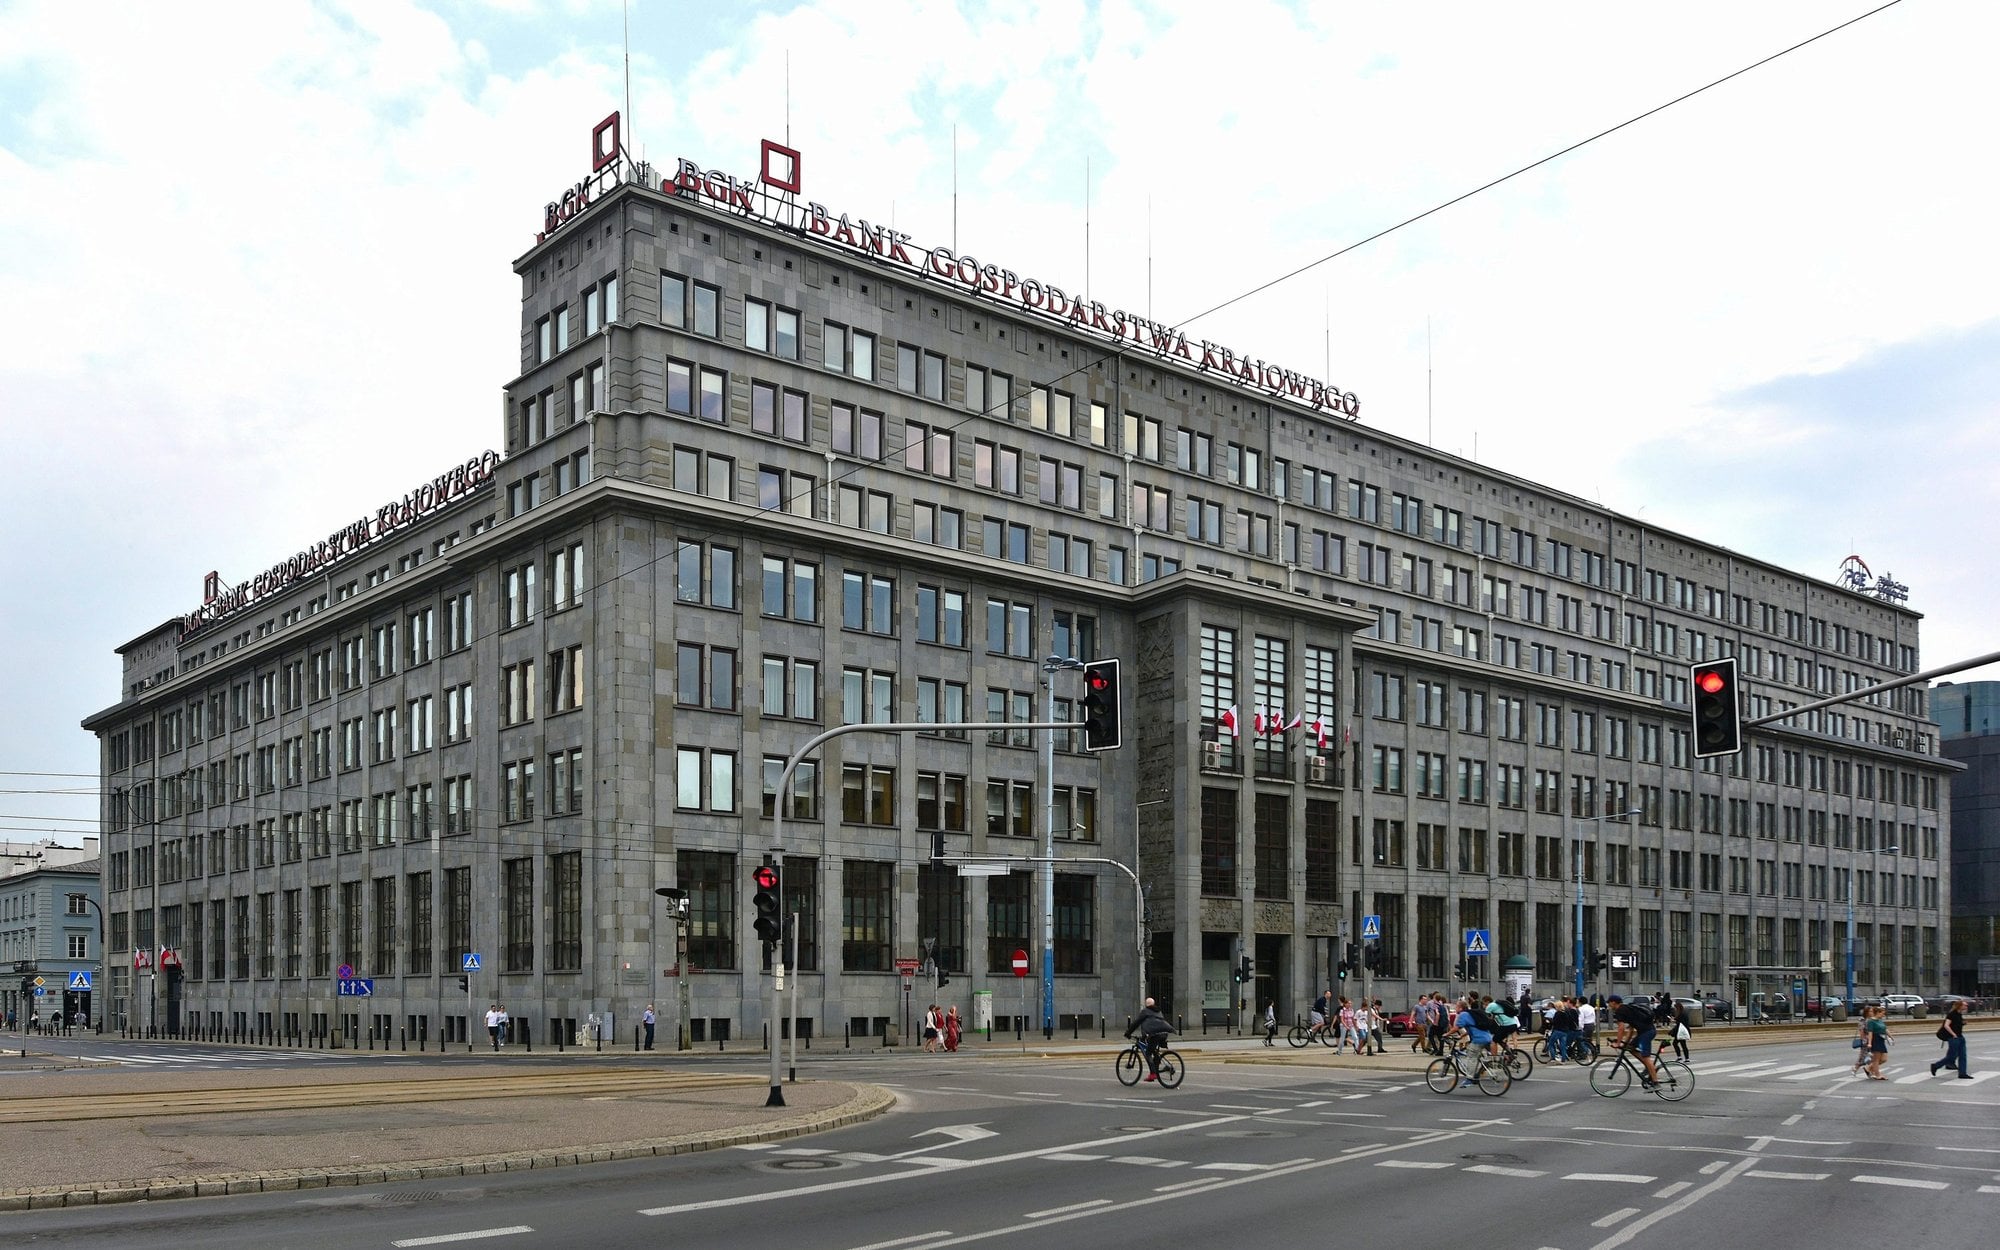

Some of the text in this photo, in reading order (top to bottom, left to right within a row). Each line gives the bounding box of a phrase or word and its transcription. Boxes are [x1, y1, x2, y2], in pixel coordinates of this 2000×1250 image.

[544, 175, 591, 234] BGK
[678, 157, 1360, 416] BGK BANK GOSPODARSTWA KRAJOWEGO
[184, 449, 496, 634] BGK BANK GOSPODARSTWA KRAJOWEGO
[1205, 979, 1228, 992] BGK
